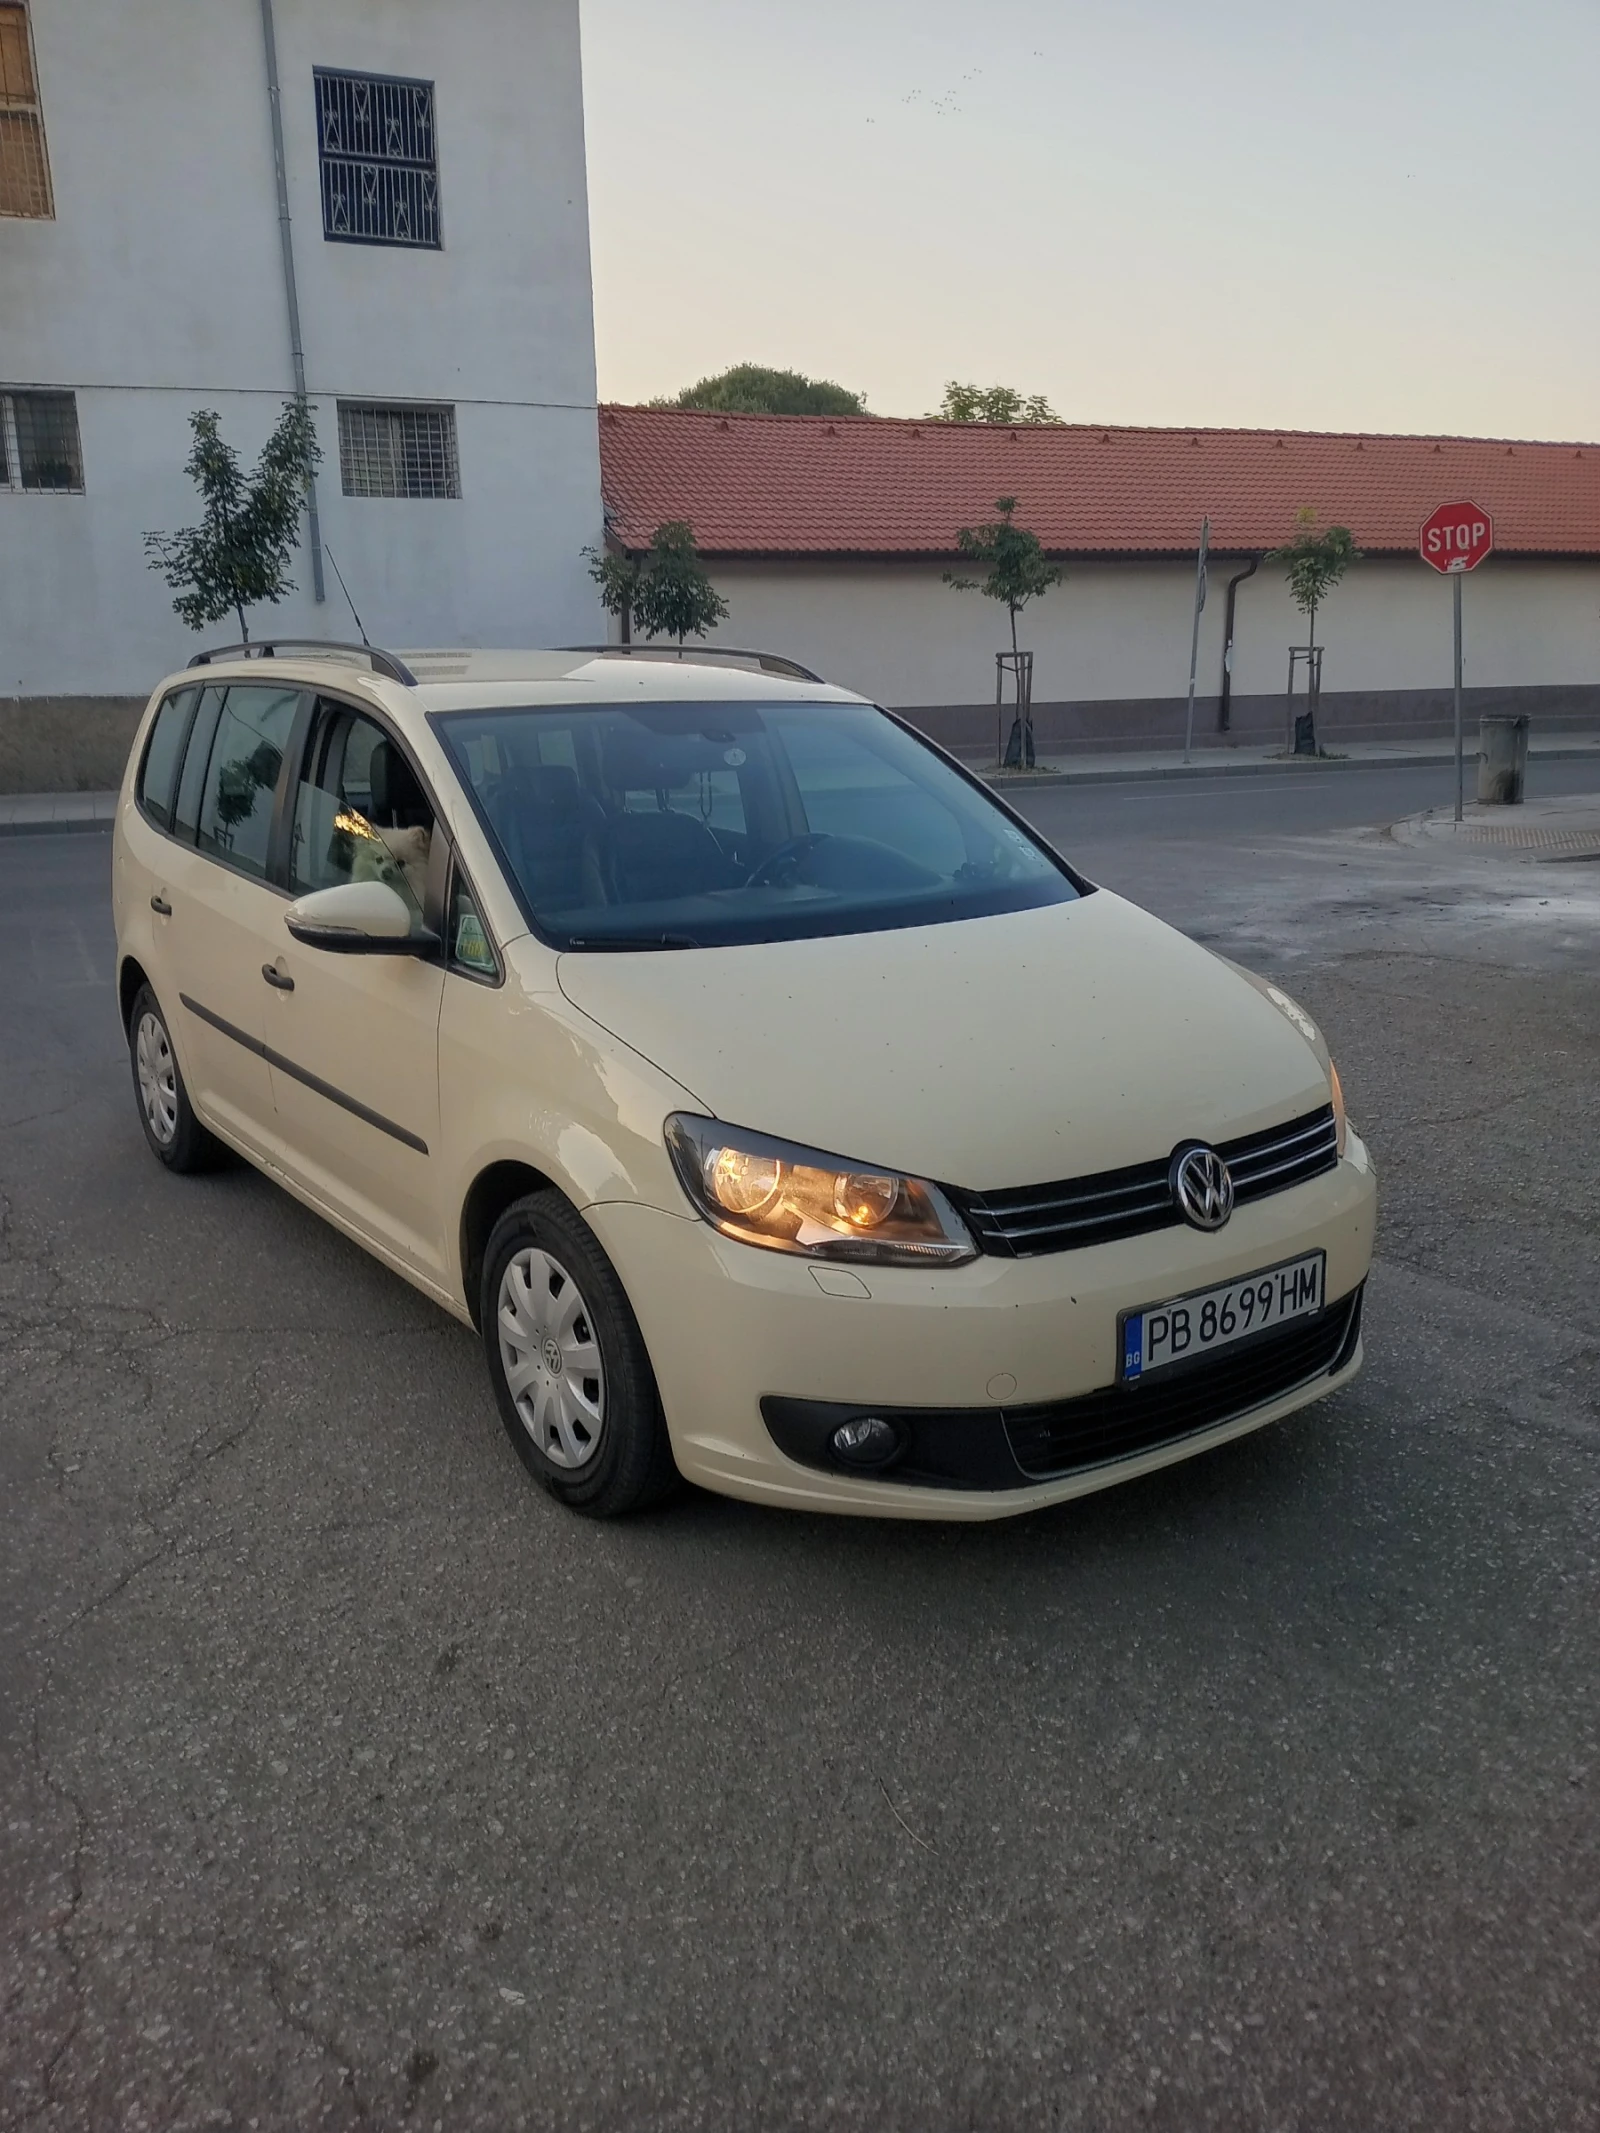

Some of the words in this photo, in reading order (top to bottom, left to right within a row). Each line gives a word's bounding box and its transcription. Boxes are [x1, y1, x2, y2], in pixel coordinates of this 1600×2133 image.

[1427, 522, 1485, 552] STOP
[1180, 1150, 1232, 1225] VW
[1148, 1308, 1191, 1361] PB
[1199, 1280, 1273, 1342] 8699
[1279, 1263, 1318, 1315] HM
[1125, 1351, 1140, 1367] BG
